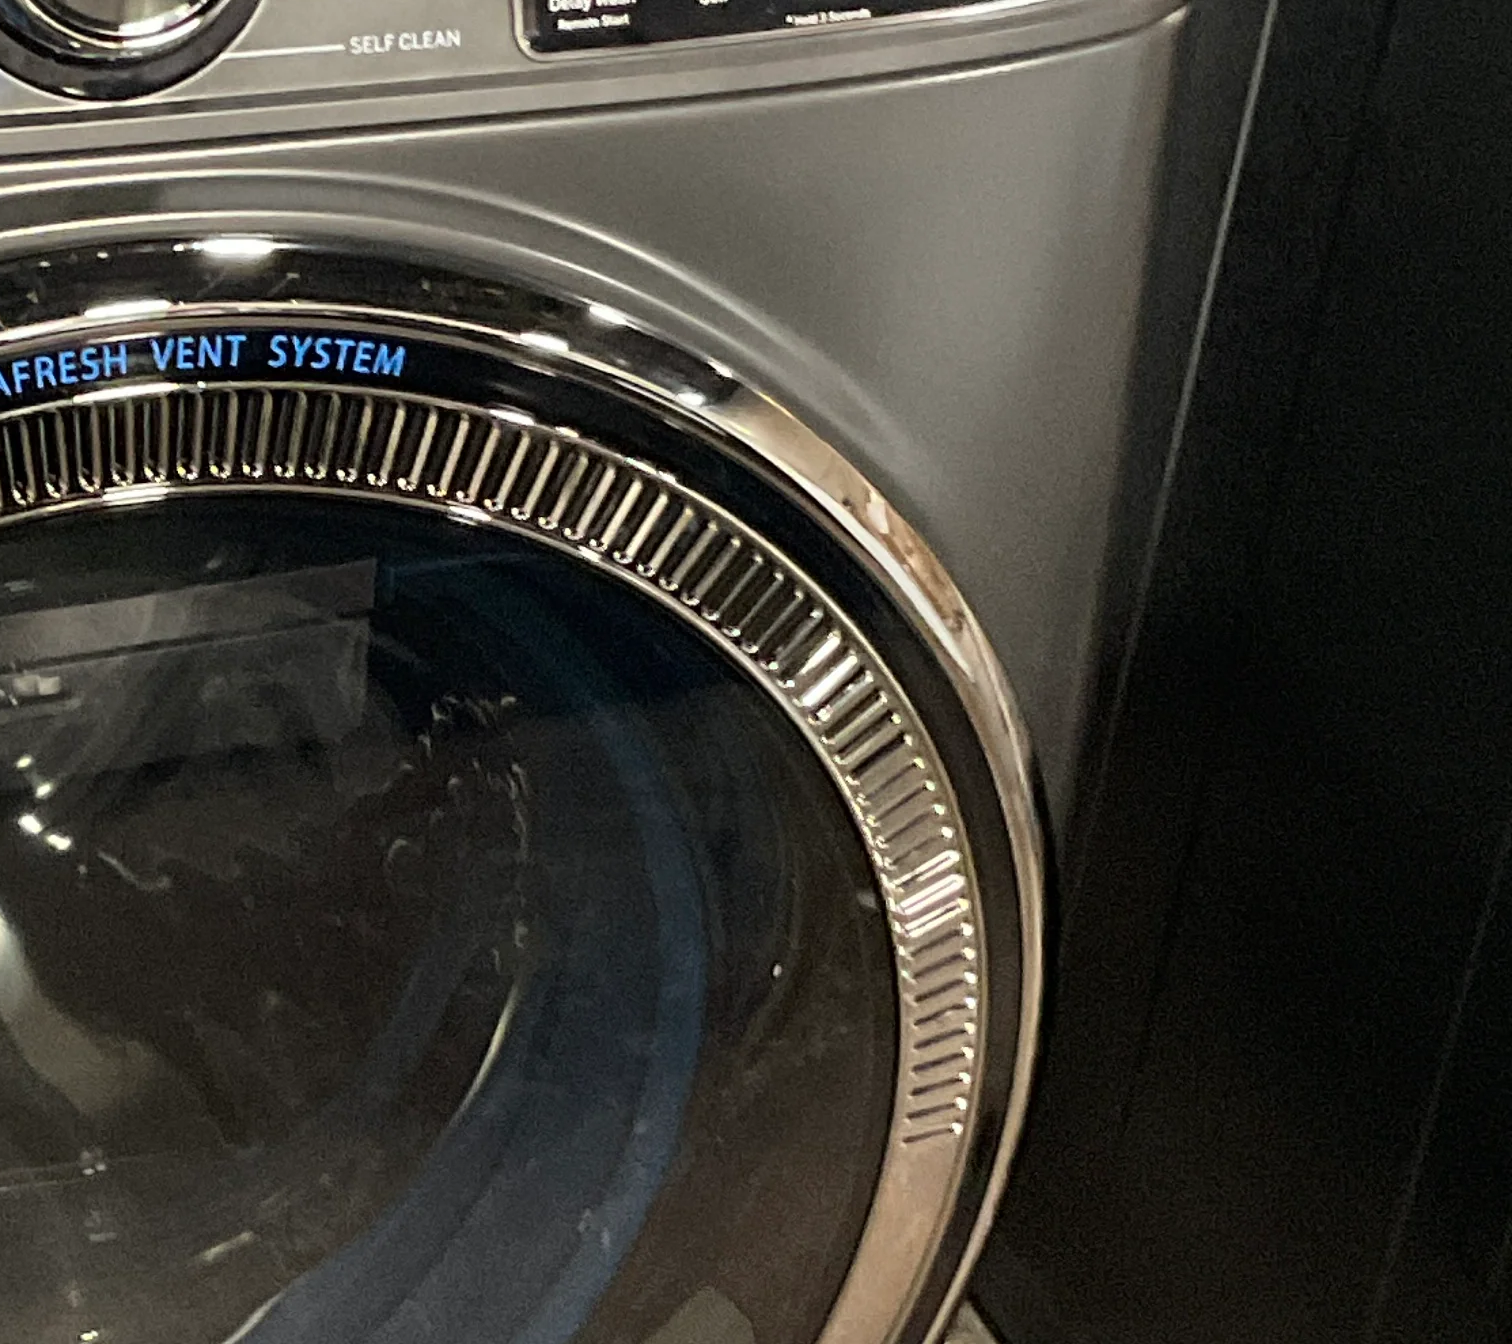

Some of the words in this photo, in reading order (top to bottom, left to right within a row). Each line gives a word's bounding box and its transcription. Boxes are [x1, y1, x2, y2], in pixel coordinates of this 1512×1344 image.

[349, 33, 395, 55] SELF
[398, 28, 462, 51] CLEAN
[150, 334, 248, 371] VENT
[267, 333, 409, 377] SYSTEM
